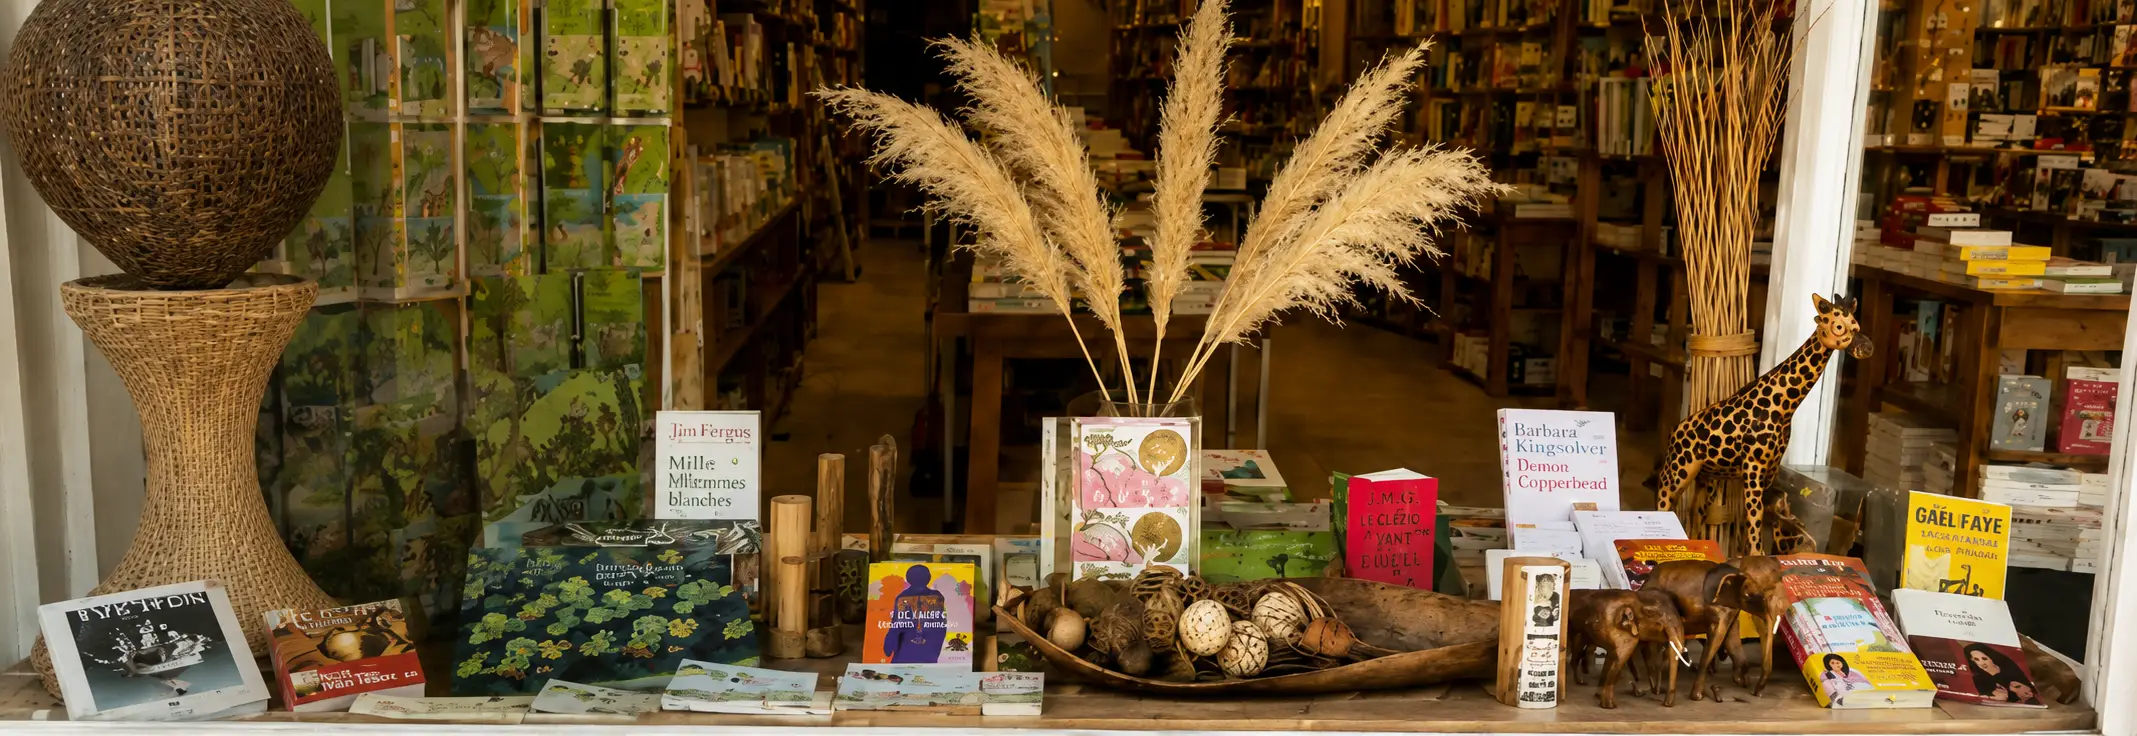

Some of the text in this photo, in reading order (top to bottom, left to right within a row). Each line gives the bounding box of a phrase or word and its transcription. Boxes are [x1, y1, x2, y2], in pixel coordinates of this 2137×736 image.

[669, 423, 751, 443] Jim Fergus
[1514, 422, 1578, 438] Barbara
[1516, 439, 1607, 456] Kingsolver
[669, 455, 715, 470] Mille
[1517, 458, 1569, 473] Demon
[669, 491, 732, 507] blanches
[1960, 513, 2003, 534] FAYE
